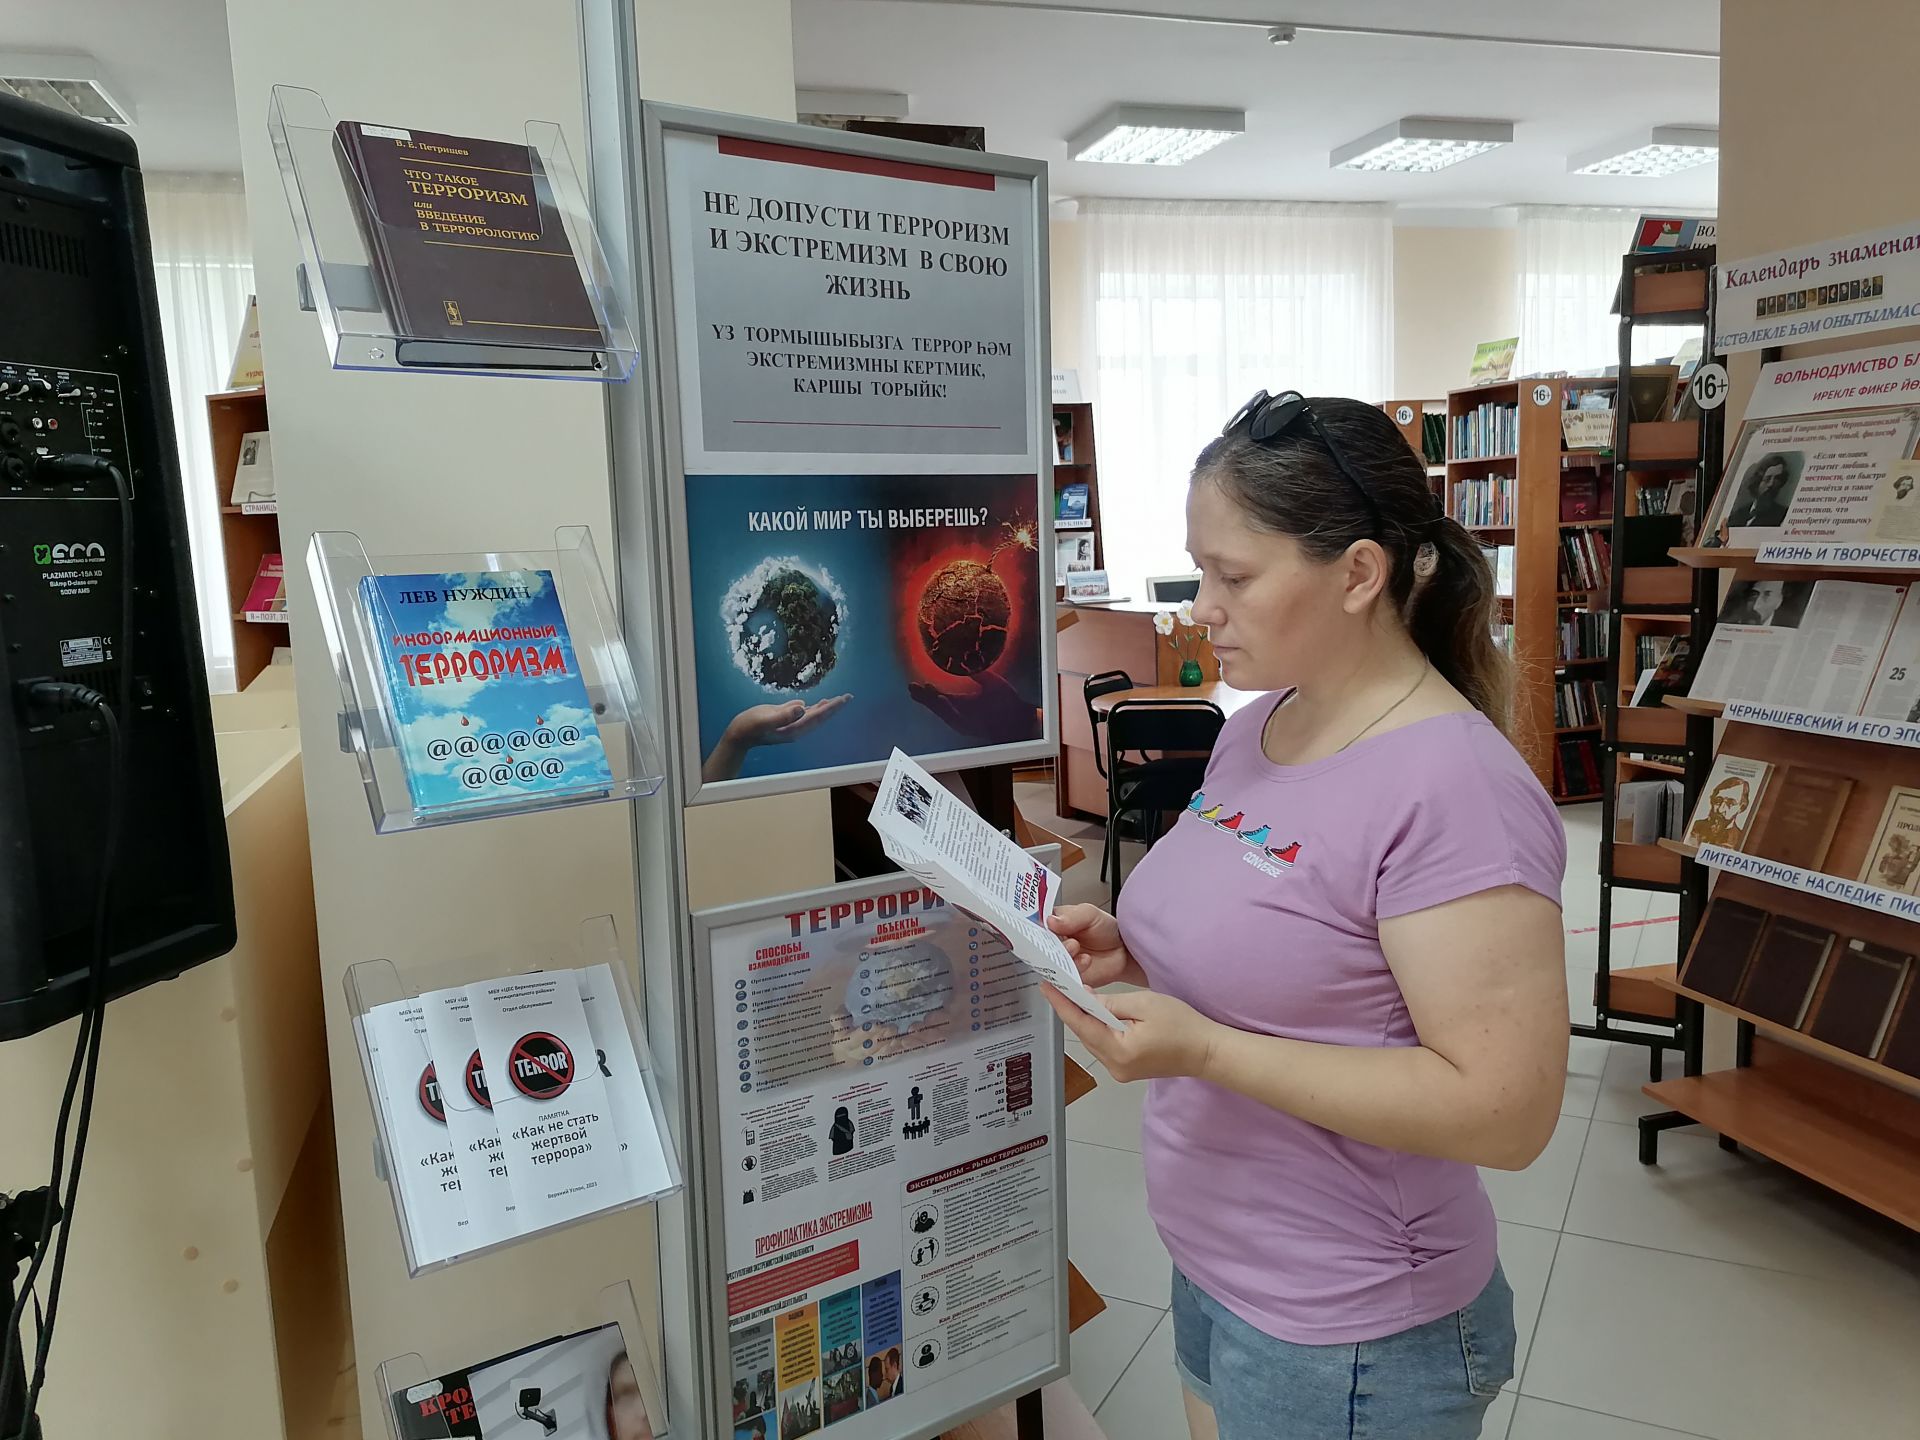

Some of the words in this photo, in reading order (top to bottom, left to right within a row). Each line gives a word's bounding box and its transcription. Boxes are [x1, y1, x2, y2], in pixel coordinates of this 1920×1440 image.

[396, 139, 407, 148] В.
[408, 141, 418, 150] Е.
[419, 142, 469, 156] Петрищев
[403, 168, 432, 182] ЧТО
[434, 172, 479, 187] ТАКОЕ
[406, 180, 529, 207] ТЕРРОРИЗМ
[413, 201, 433, 210] или
[416, 209, 487, 226] ВВЕДЕНИЕ
[703, 190, 740, 216] НЕ
[746, 196, 870, 232] ДОПУСТИ
[877, 212, 1011, 246] ТЕРРОРИЗМ
[420, 221, 430, 232] В
[432, 222, 540, 242] ТЕРРОРОЛОГИЮ
[709, 228, 728, 251] И
[736, 230, 908, 269] ЭКСТРЕМИЗМ
[920, 250, 934, 270] В
[939, 252, 1008, 278] СВОЮ
[1725, 256, 1820, 289] Календарь
[825, 274, 911, 301] ЖИЗНЬ
[743, 325, 904, 351] ТОРМЫШЫБЫЗГА
[911, 336, 973, 355] ТЕРРОР
[746, 351, 899, 374] ЭКСТРЕМИЗМНЫ
[903, 359, 986, 379] КЕРТМИК,
[1774, 356, 1898, 385] ВОЛЬНОДУМСТВО
[793, 377, 863, 396] КАРШЫ
[870, 380, 948, 399] ТОРЫЙК!
[1533, 388, 1551, 401] 16+
[1694, 374, 1728, 400] 16+
[1812, 386, 1855, 402] ИРЕКЛЕ
[1858, 381, 1898, 395] ФИКЕР
[1901, 377, 1920, 391] ЙӨ
[1396, 409, 1413, 421] 16+
[748, 505, 809, 532] КАКОЙ
[813, 511, 853, 531] МИР
[857, 510, 884, 529] ТЫ
[888, 507, 988, 529] ВЫБЕРЕШЬ?
[1763, 547, 1813, 559] ЖИЗНЬ
[1816, 549, 1827, 560] И
[400, 590, 438, 604] ЛЕВ
[442, 585, 531, 603] НУЖДИН
[392, 623, 557, 647] ИНФОРМАЦИОННЫЙ
[399, 645, 567, 687] ТЕРРОРИЗМ
[1889, 667, 1907, 681] 25
[1729, 703, 1844, 733] ЧЕРНЫШЕВСКИЙ
[1847, 721, 1859, 734] И
[1861, 723, 1890, 740] ЕГО
[1028, 865, 1044, 910] ТЕРРОРА
[1700, 848, 1801, 884] ЛИТЕРАТУРНОЕ
[1805, 876, 1885, 906] НАСЛЕДИЕ
[1013, 872, 1025, 911] ВМЕСТЕ
[1021, 872, 1034, 912] ПРОТИВ
[877, 917, 919, 935] ОБЪЕКТЫ
[755, 942, 802, 961] СПОСОБЫ
[514, 1051, 568, 1079] TERROR
[512, 1125, 546, 1141] «Как
[548, 1120, 564, 1133] не
[566, 1112, 599, 1128] стать
[538, 1110, 570, 1122] ПАМЯТКА
[531, 1127, 588, 1151] жертвой
[531, 1142, 593, 1166] террора»
[909, 1167, 964, 1191] ЭКСТРЕМИЗМ
[998, 1138, 1045, 1161] ТЕРРОРИЗМА
[755, 1219, 818, 1256] ПРОФИЛАКТИКА
[819, 1201, 873, 1233] ЭКСТРЕМИЗМА
[419, 1387, 473, 1417] КРО
